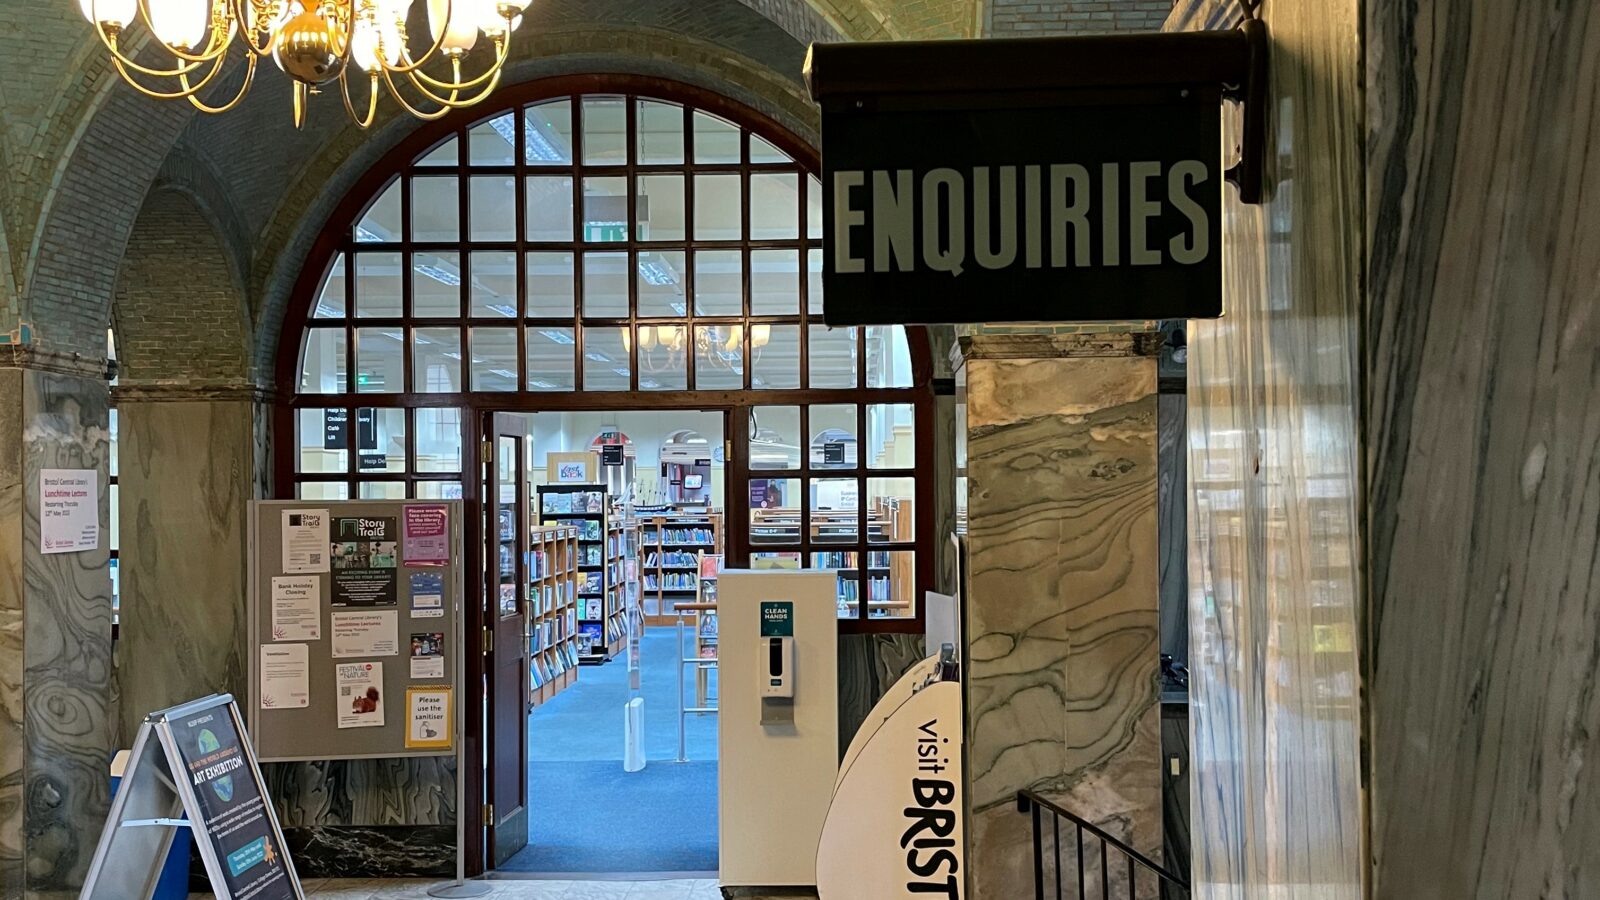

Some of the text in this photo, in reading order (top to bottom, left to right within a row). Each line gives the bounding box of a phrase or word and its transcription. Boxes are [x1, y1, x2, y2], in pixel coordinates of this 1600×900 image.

[834, 160, 1209, 277] ENQUIRIES
[359, 518, 385, 529] Story
[194, 756, 243, 786] ART EXHIBITION
[900, 719, 958, 900] visit BRIST
